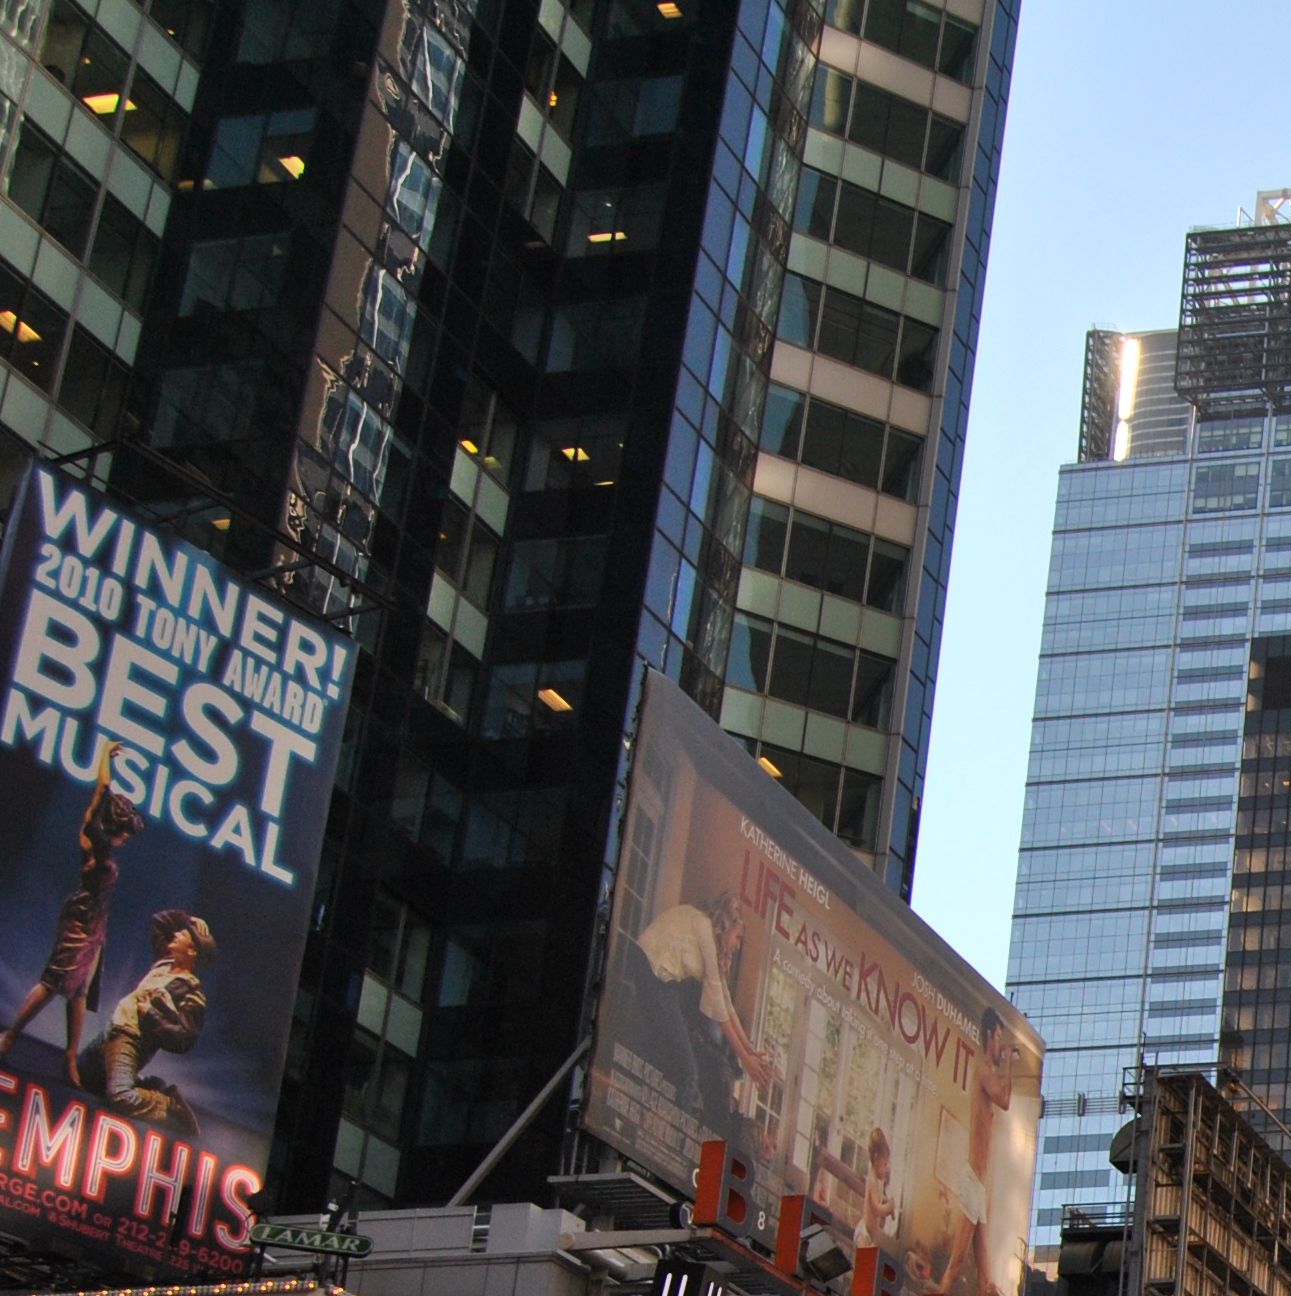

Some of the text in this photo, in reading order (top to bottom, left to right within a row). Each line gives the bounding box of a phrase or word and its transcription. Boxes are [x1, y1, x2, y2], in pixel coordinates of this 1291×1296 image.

[34, 543, 124, 622] 2010
[135, 594, 218, 675] TONY
[36, 468, 349, 702] WINNER!
[12, 588, 318, 818] BEST
[0, 687, 294, 887] MUSICAL
[740, 815, 831, 910] KATHERINE HEIGL
[739, 850, 975, 1092] LIFE AS WE KNOW IT
[936, 993, 981, 1046] DUHAMEL
[258, 1227, 362, 1253] LAMAR
